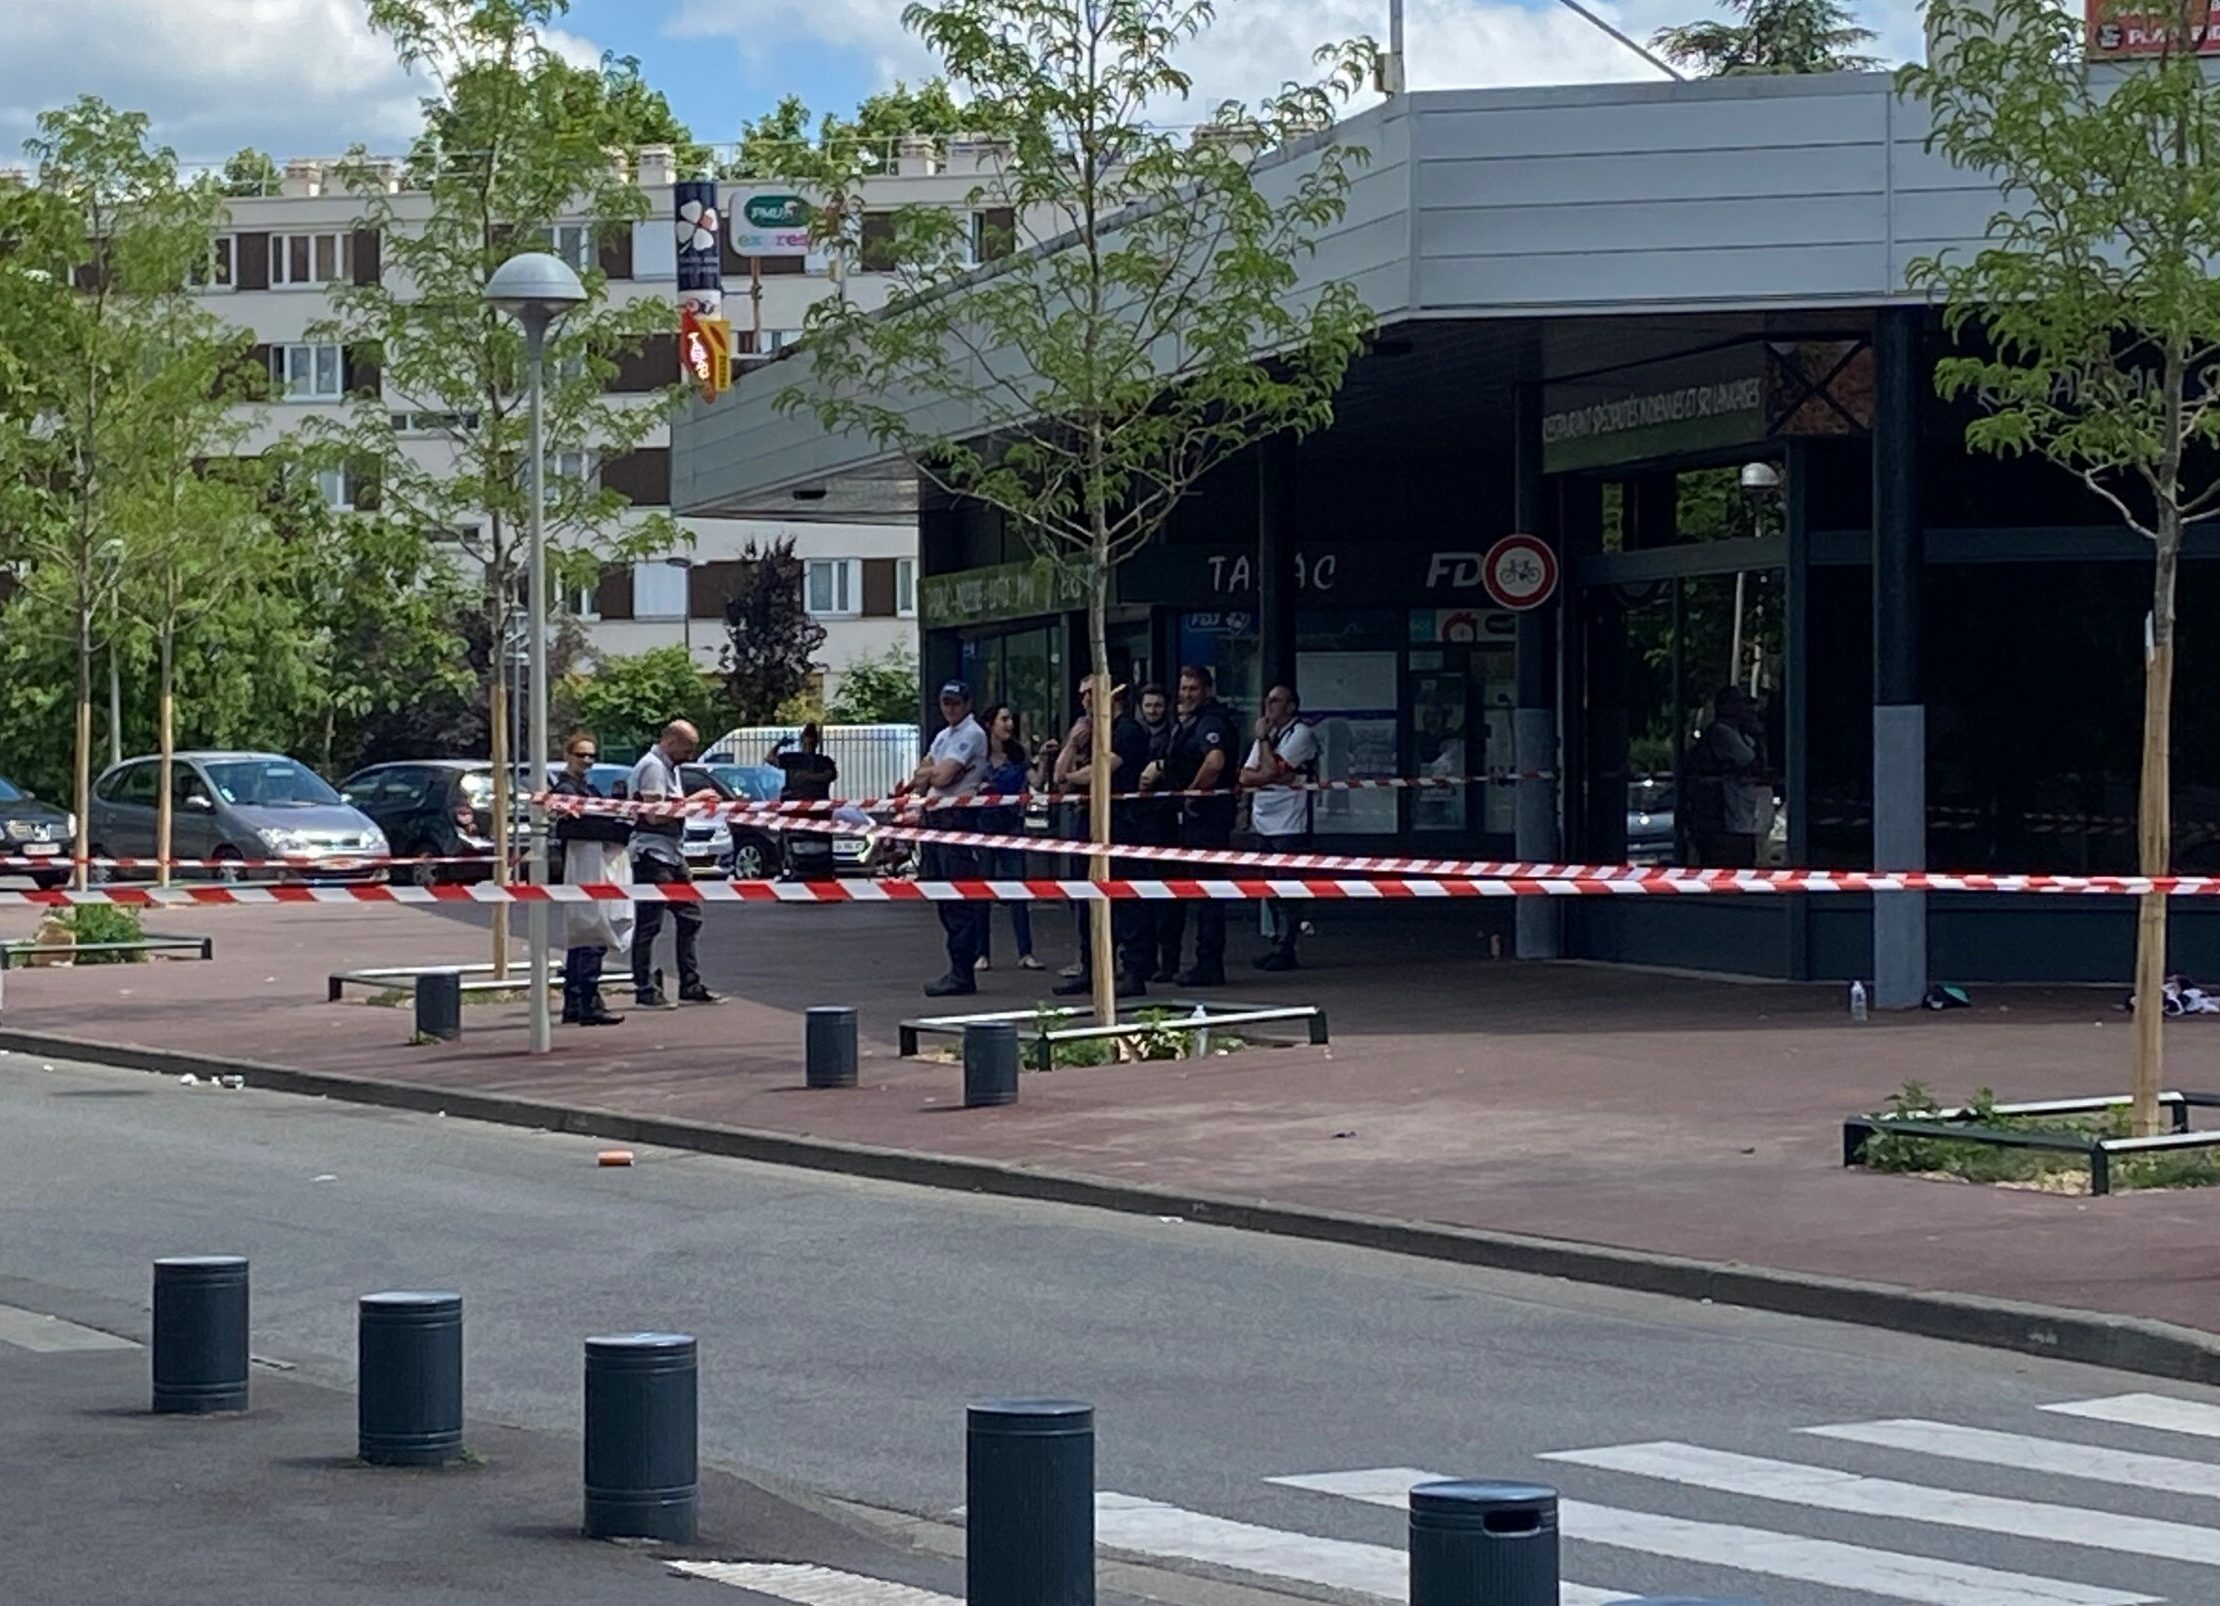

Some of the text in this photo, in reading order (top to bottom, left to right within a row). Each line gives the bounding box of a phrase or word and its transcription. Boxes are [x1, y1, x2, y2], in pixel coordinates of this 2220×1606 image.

[750, 206, 783, 220] PMU
[1426, 552, 1485, 589] FD
[1191, 612, 1221, 627] FDJ
